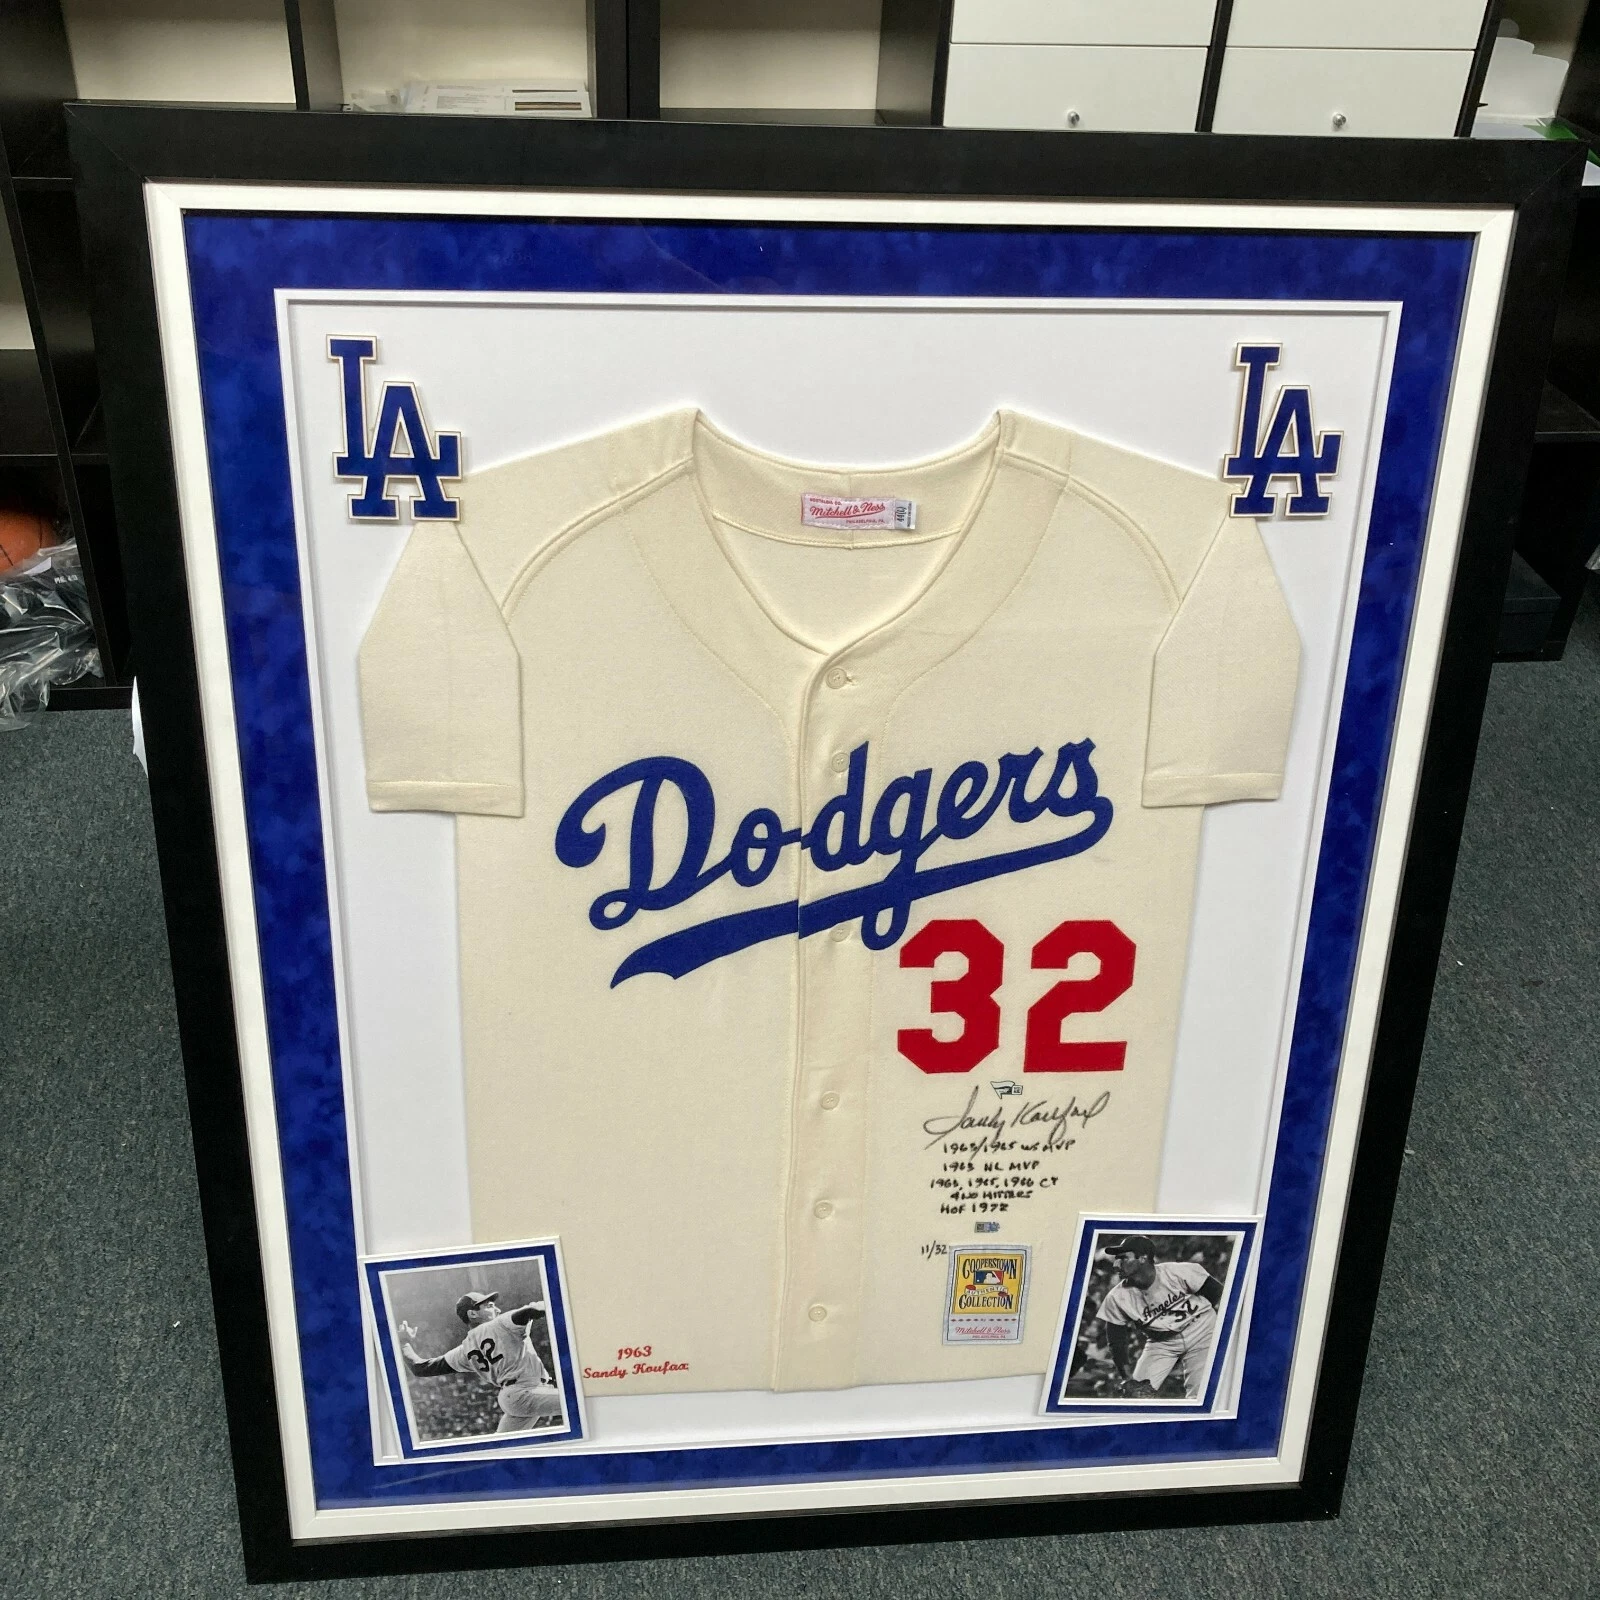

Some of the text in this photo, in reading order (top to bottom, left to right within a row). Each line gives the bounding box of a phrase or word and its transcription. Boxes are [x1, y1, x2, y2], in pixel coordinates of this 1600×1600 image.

[326, 334, 463, 522] LA
[1223, 342, 1344, 519] LA
[810, 502, 886, 516] Mitchell & Ness
[554, 738, 1113, 988] Dodgers
[897, 919, 1137, 1074] 32
[943, 1160, 1040, 1172] 1963 NL MVP
[1004, 1177, 1034, 1188] 1966
[972, 1203, 1009, 1214] 1972
[921, 1240, 948, 1260] 11/32
[962, 1258, 1018, 1280] COOPERSTOWN
[959, 1294, 1014, 1310] COLLECTION
[1142, 1290, 1187, 1322] Angeles
[955, 1326, 987, 1335] Mitchell
[993, 1326, 1012, 1334] Ness
[467, 1338, 504, 1373] 32
[617, 1345, 652, 1361] 1963
[583, 1361, 689, 1379] Sandy Koufax
